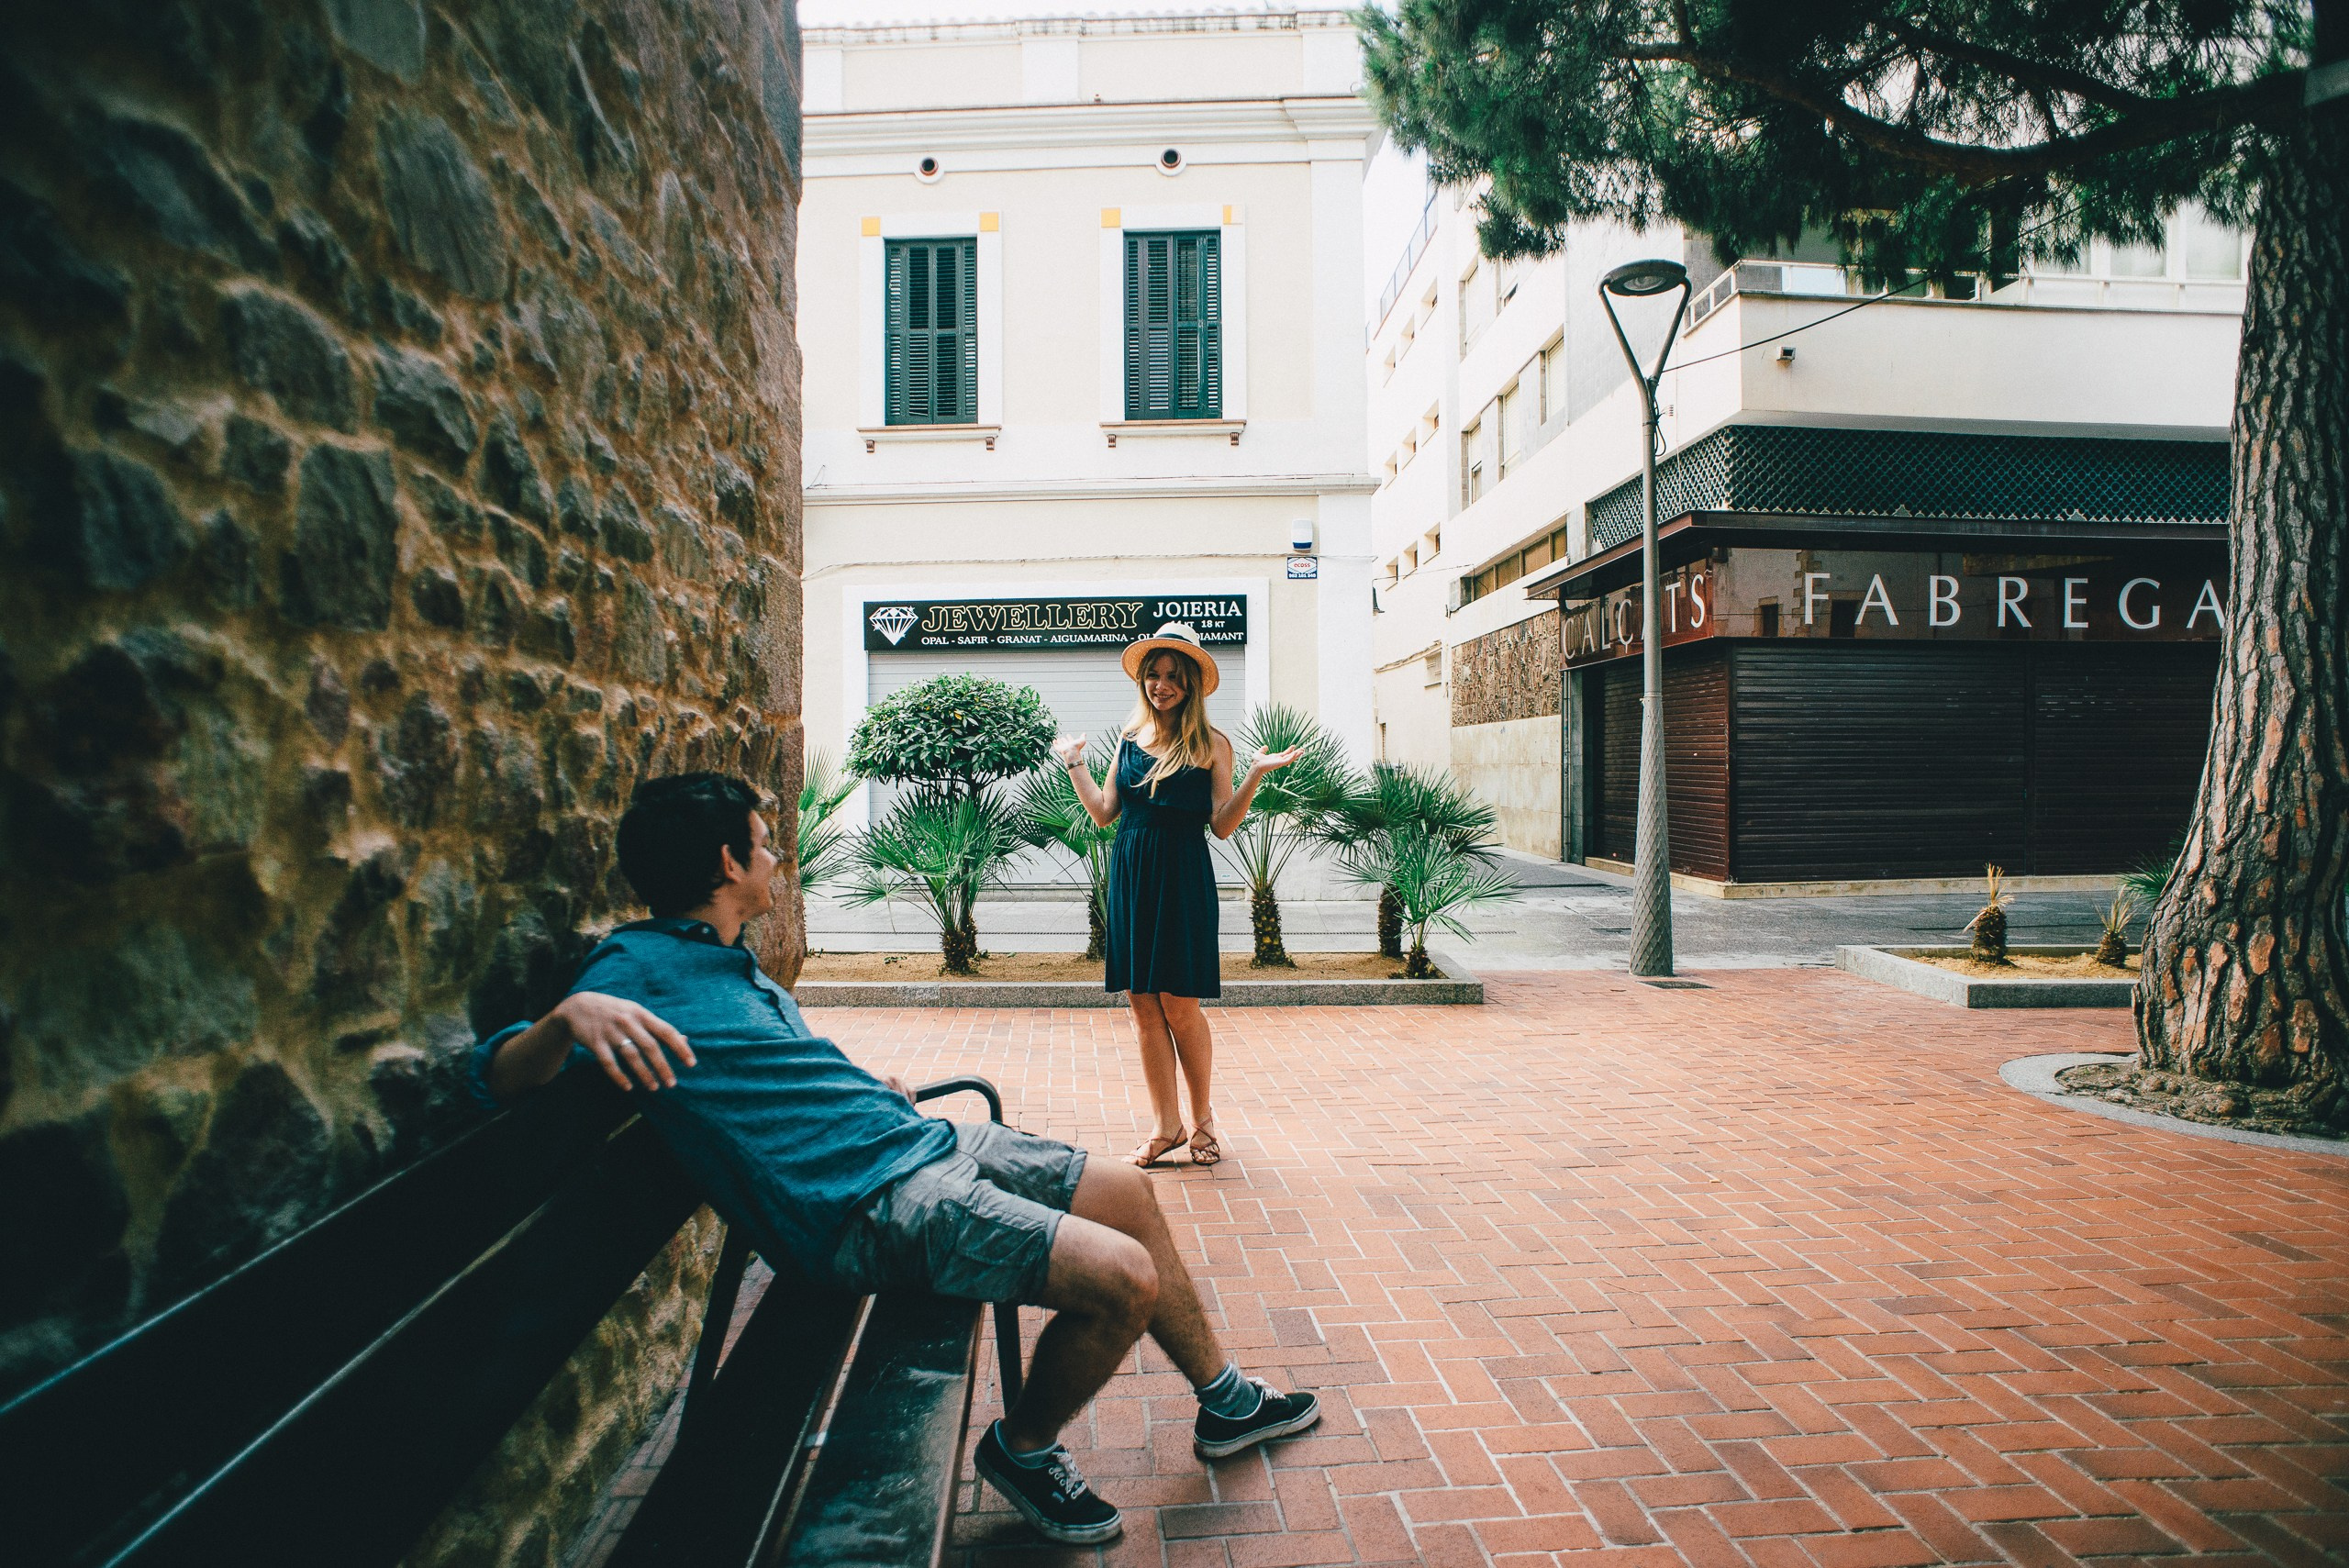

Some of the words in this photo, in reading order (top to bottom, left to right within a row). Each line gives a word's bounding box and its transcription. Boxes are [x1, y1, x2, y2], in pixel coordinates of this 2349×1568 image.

[1152, 601, 1242, 617] JOIERIA
[1563, 573, 1706, 660] CALÇTS
[921, 602, 1144, 633] JEWELLERY
[1201, 619, 1212, 628] 18
[921, 636, 949, 645] OPAL
[957, 636, 988, 644] SAFIR
[996, 635, 1042, 644] GRANAT
[1050, 633, 1129, 643] AIGUAMARINA
